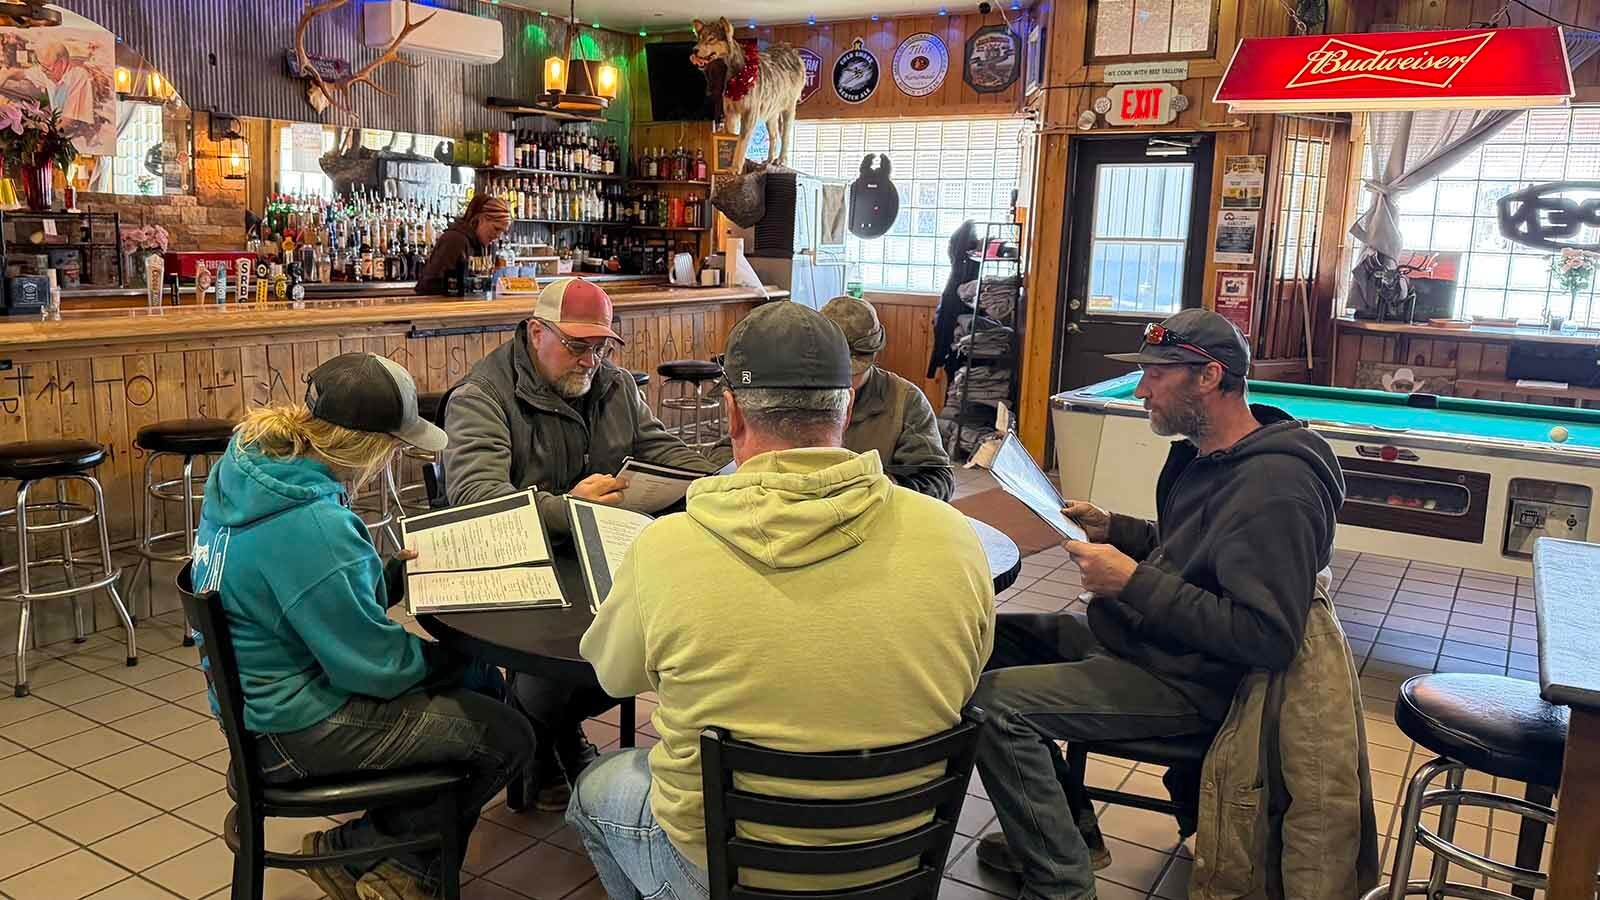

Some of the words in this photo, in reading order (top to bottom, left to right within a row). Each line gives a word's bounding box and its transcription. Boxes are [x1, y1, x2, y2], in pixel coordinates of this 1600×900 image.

[908, 43, 932, 55] Tito's
[1307, 49, 1468, 75] Budweiser
[1121, 88, 1163, 119] EXIT
